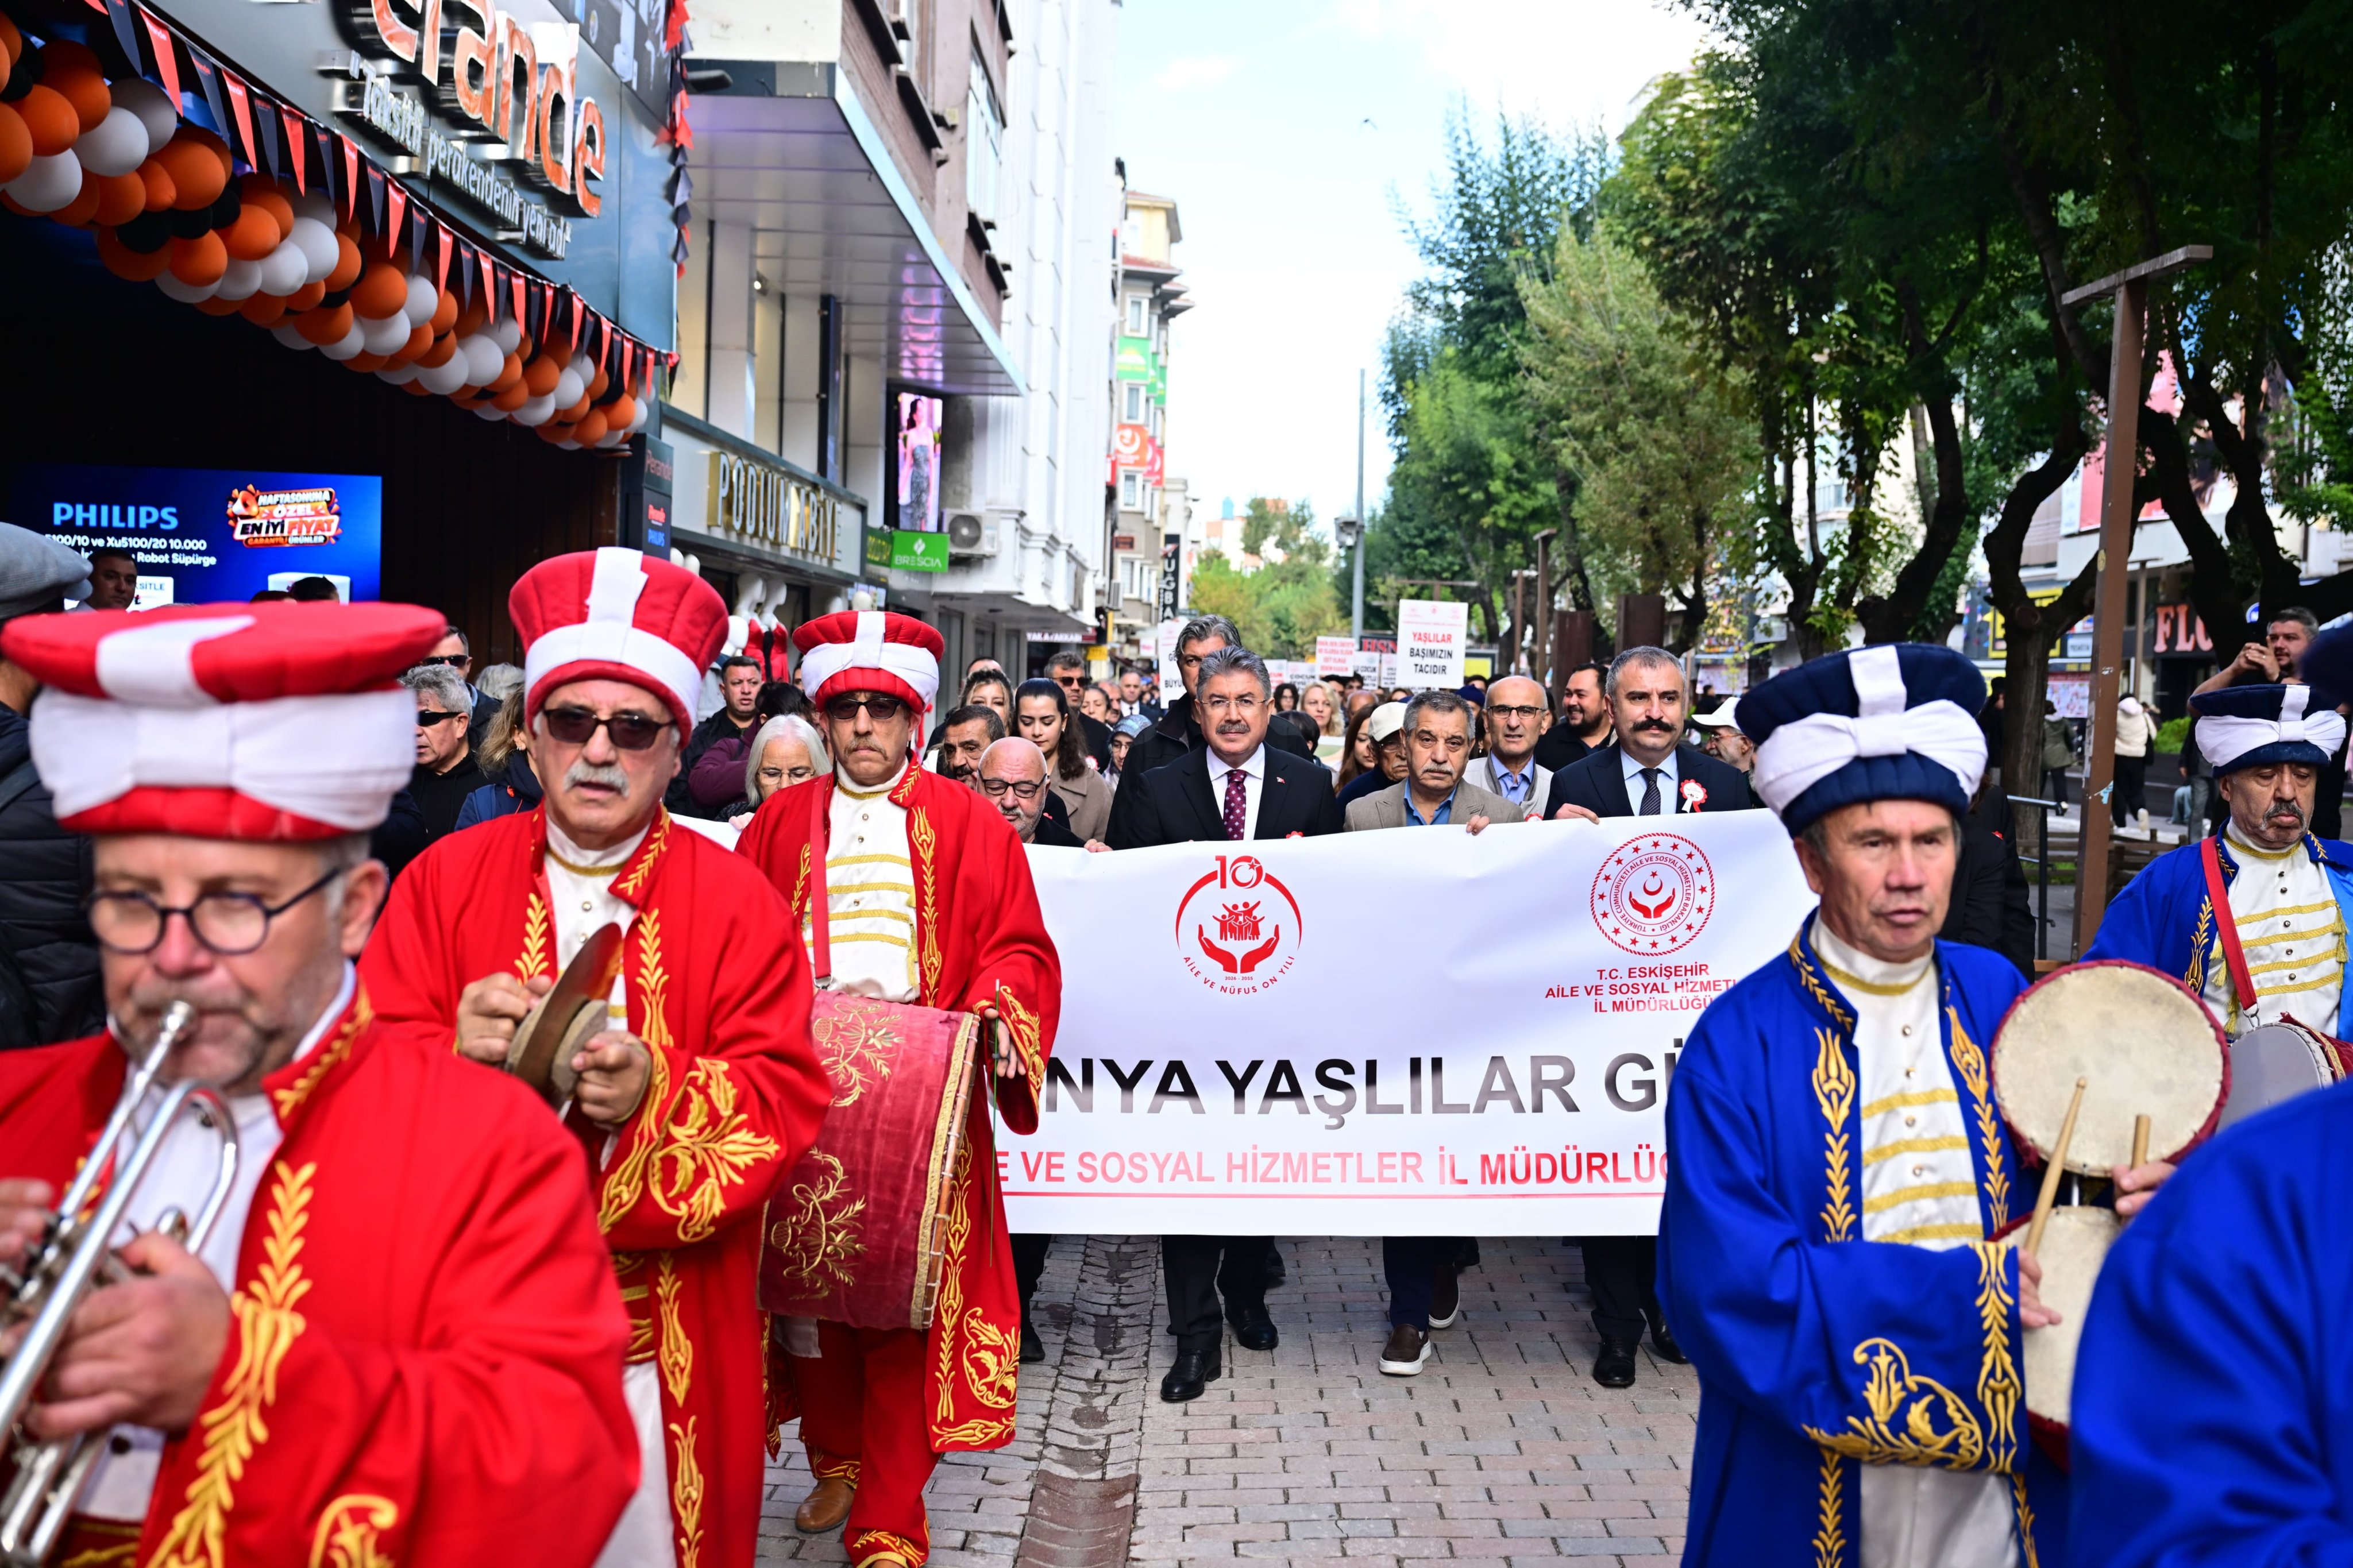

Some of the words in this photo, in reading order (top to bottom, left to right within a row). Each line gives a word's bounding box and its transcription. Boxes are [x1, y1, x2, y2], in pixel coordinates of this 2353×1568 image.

[426, 127, 519, 225] perakendenin
[522, 202, 547, 245] yeni
[259, 491, 331, 506] HAFTASONUNA
[53, 502, 179, 530] PHILIPS
[273, 503, 315, 518] ÖZEL
[240, 522, 263, 535] EN
[265, 520, 285, 535] İYİ
[287, 516, 334, 535] FİYAT
[91, 538, 105, 547] ve
[106, 536, 167, 550] Xu5100/20
[169, 538, 207, 550] 10.000
[288, 535, 325, 544] ÜRÜNLER
[648, 528, 665, 547] PHILIPS
[137, 552, 170, 564] Robot
[172, 552, 217, 567] Süpürge
[894, 555, 942, 568] BRESCIA
[1163, 551, 1176, 620] UĞBA
[1412, 632, 1453, 644] YAŞLILAR
[1410, 647, 1453, 661] BAŞIMIZIN
[1414, 664, 1447, 675] TACIDIR
[1630, 859, 1644, 871] AİLE
[1655, 855, 1678, 868] SOSYAL
[1613, 868, 1630, 914] CUMHURİYETİ
[1677, 865, 1692, 902] HİZMETLER
[1619, 913, 1646, 933] TÜRKİYE
[1660, 902, 1689, 932] BAKANLIĞI
[1183, 956, 1201, 978] AİLE
[1203, 977, 1216, 988] VE
[1220, 985, 1257, 995] NÜFUS
[1262, 976, 1278, 989] ON
[1278, 956, 1295, 975] YILI
[1596, 968, 1623, 980] T.C.
[1628, 961, 1710, 980] ESKİŞEHİR
[1545, 985, 1580, 998] AİLE
[1584, 985, 1604, 996] VE
[1608, 982, 1670, 995] SOSYAL
[1675, 978, 1737, 993] HİZMET
[1595, 998, 1608, 1013] İL
[1612, 995, 1714, 1013] MÜDÜRLÜĞÜ
[1044, 1056, 1206, 1114] NYA
[1214, 1055, 1581, 1130] YAŞLILAR
[1021, 1152, 1066, 1183] VE
[1077, 1150, 1215, 1183] SOSYAL
[1226, 1144, 1424, 1183] HİZMETLER
[1439, 1146, 1468, 1184] İL
[1480, 1144, 1667, 1185] MÜDÜRLÜ
